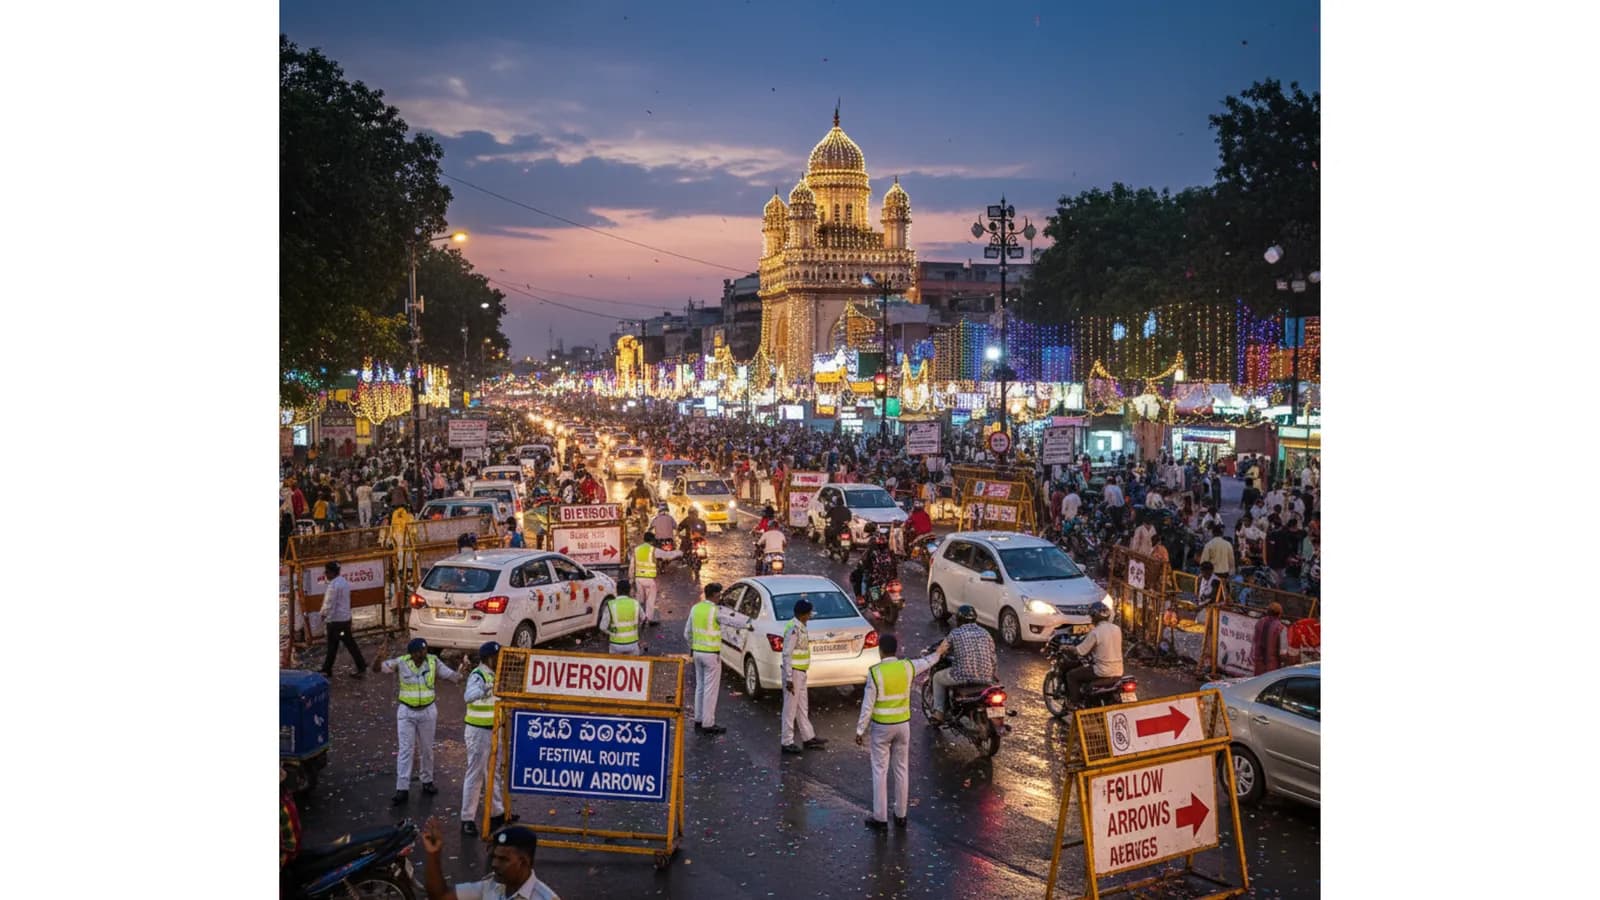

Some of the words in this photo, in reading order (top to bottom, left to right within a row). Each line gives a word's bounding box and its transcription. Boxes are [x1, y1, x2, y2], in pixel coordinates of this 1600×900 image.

[531, 660, 644, 693] DIVERSION
[539, 747, 595, 764] FESTIVAL
[599, 750, 640, 767] ROUTE
[523, 767, 584, 788] FOLLOW
[589, 771, 656, 793] ARROWS
[1106, 767, 1164, 804] FOLLOW
[1107, 799, 1171, 838] ARROWS
